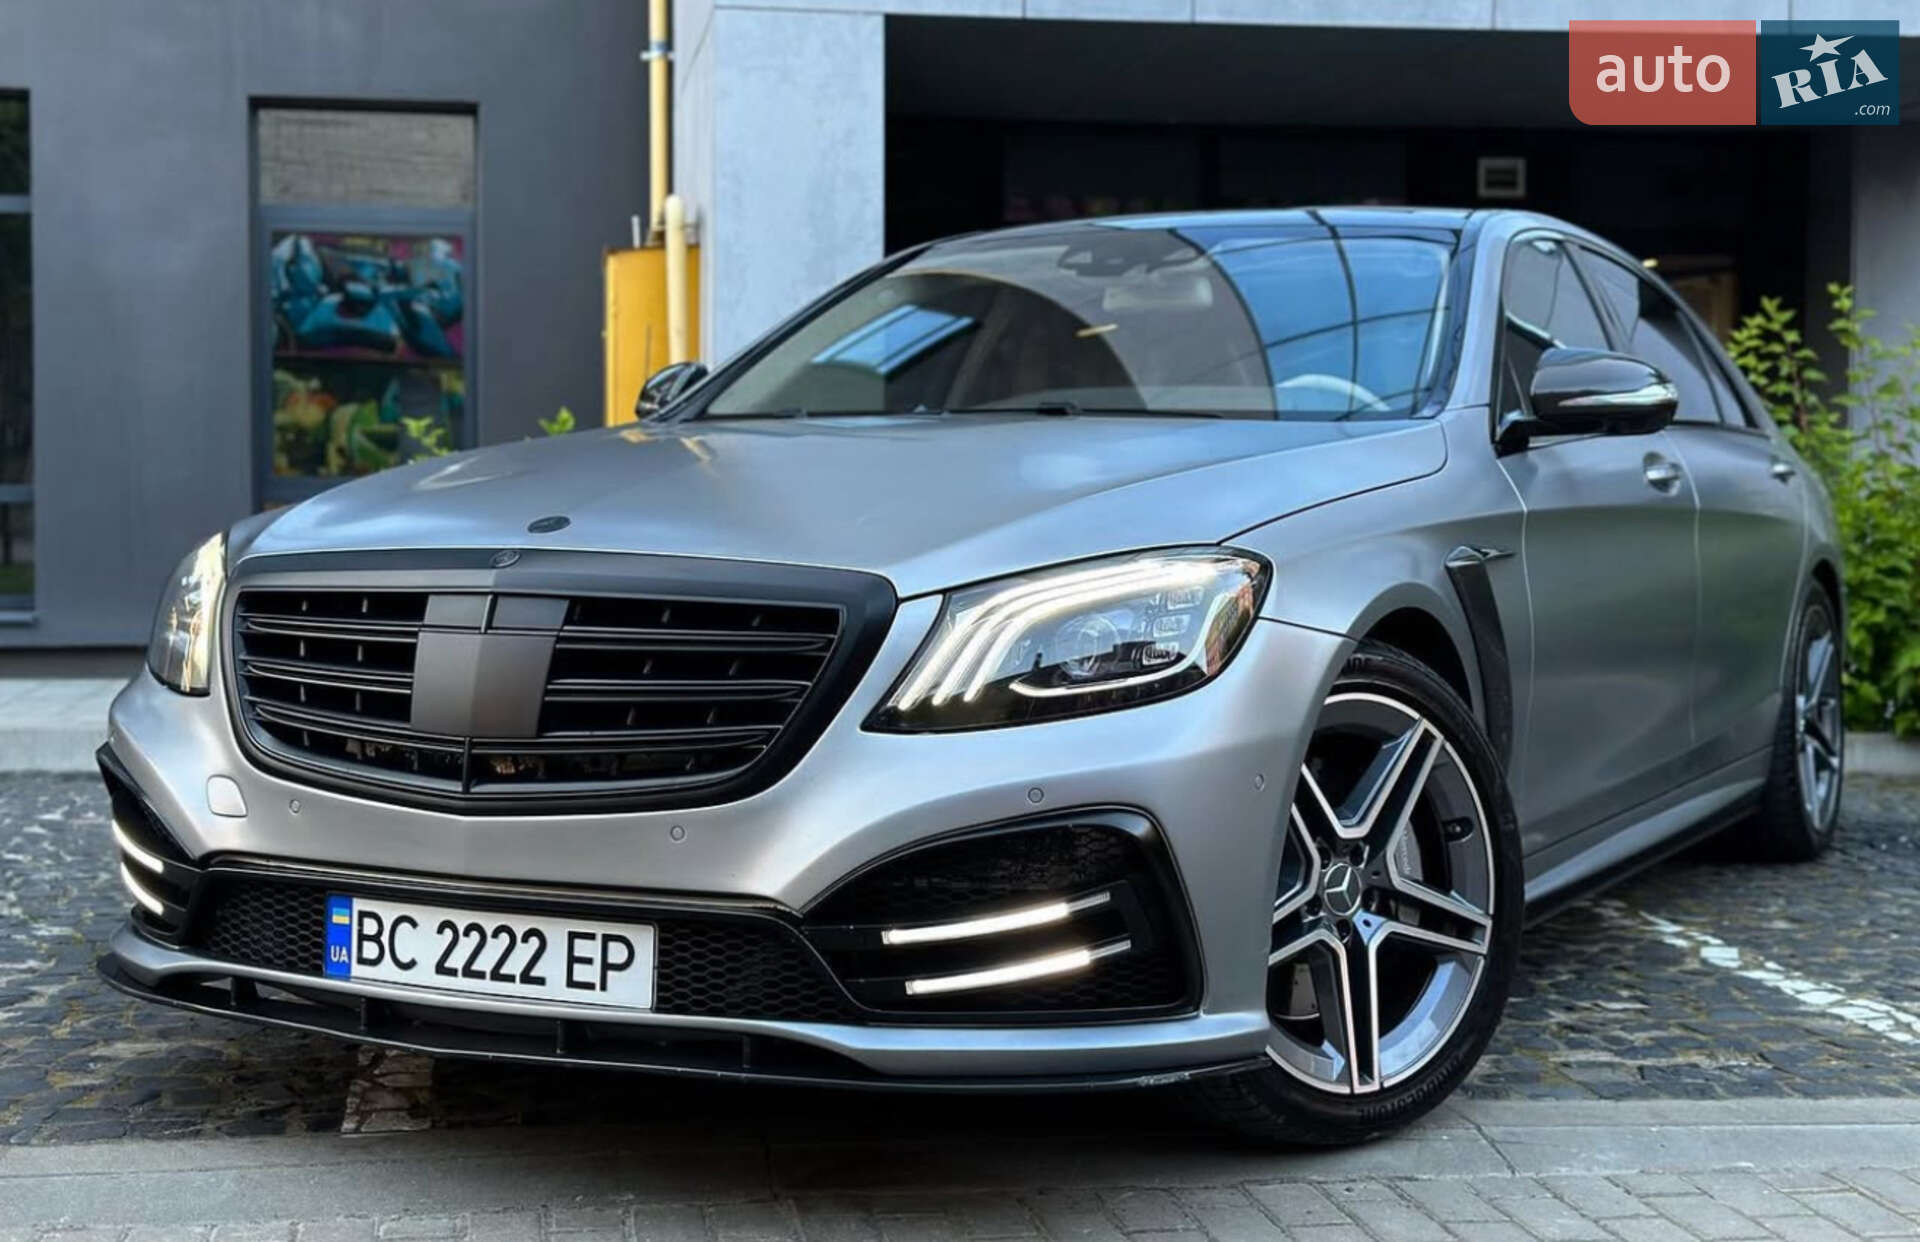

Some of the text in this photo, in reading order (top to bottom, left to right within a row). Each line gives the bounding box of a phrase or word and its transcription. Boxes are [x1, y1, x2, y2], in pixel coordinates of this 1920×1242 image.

[330, 945, 349, 963] UA
[356, 910, 635, 992] BC 2222 EP
